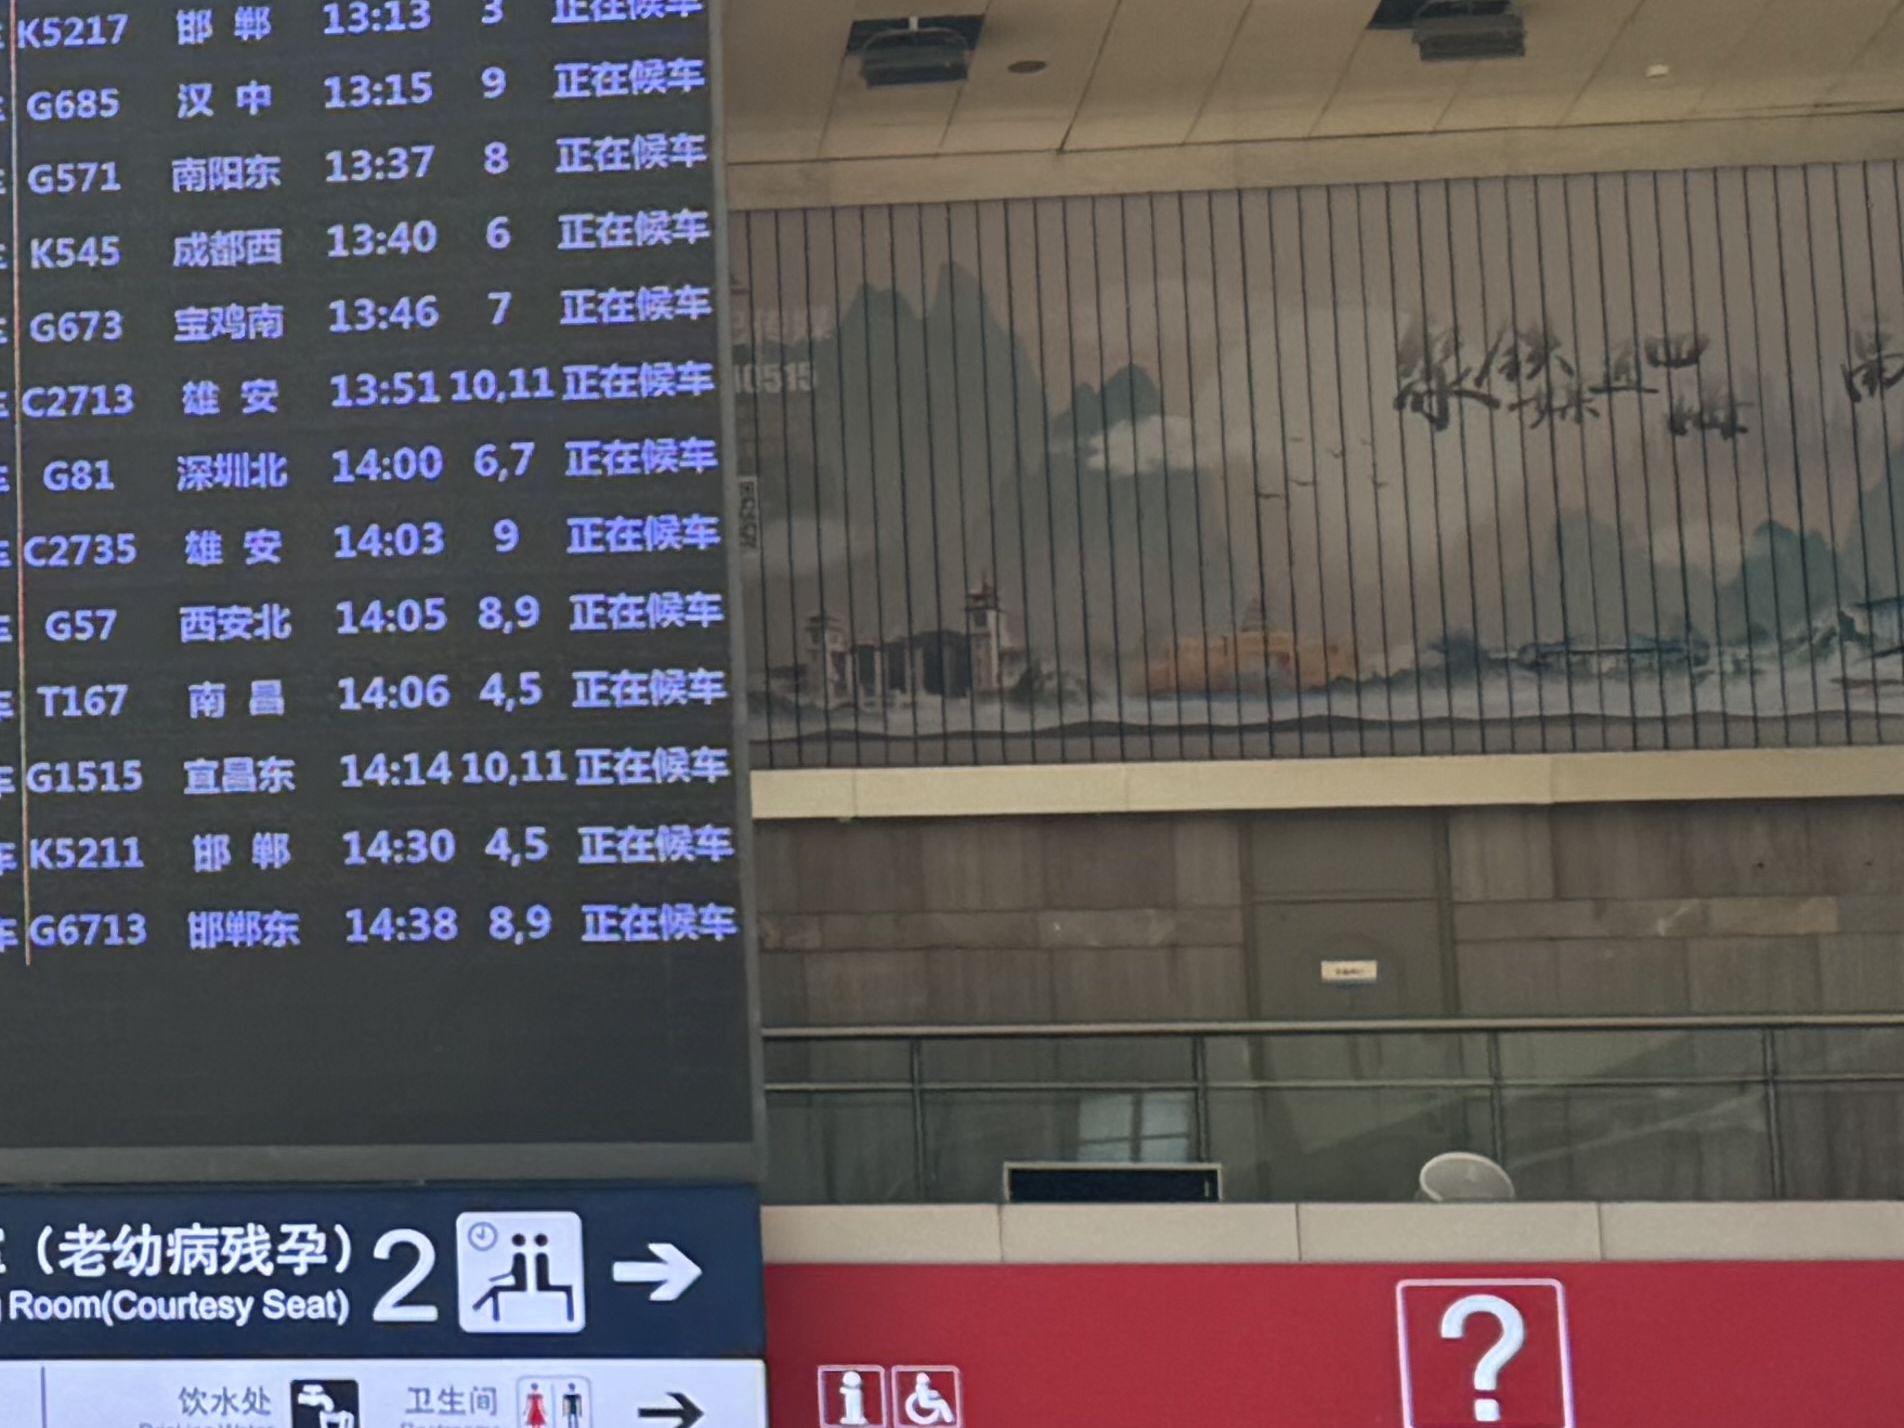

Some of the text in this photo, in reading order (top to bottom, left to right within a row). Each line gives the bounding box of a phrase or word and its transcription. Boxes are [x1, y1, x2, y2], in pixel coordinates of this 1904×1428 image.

[28, 162, 121, 194] G571
[327, 145, 434, 181] 13:37
[485, 142, 508, 174] 8
[556, 133, 707, 172] 正在候车
[30, 310, 122, 342] G673
[330, 296, 439, 332] 13:46
[488, 292, 511, 324] 7
[560, 285, 711, 324] 正在候车
[44, 460, 114, 491] G81
[333, 446, 442, 482] 14:00
[475, 442, 534, 481] 6,7
[565, 437, 718, 476] 正在候车
[46, 609, 116, 640] G57
[337, 598, 447, 633] 14:05
[479, 595, 539, 633] 8,9
[570, 592, 723, 630] 正在候车
[29, 913, 147, 947] G6713
[346, 907, 458, 942] 14:38
[490, 905, 551, 944] 8,9
[582, 903, 737, 941] 正在候车
[373, 1229, 438, 1321] 2
[10, 1290, 254, 1326] Room(Courtesy
[263, 1289, 349, 1325] Seat)
[179, 1386, 271, 1416] 饮水处
[405, 1386, 497, 1416] 卫生间
